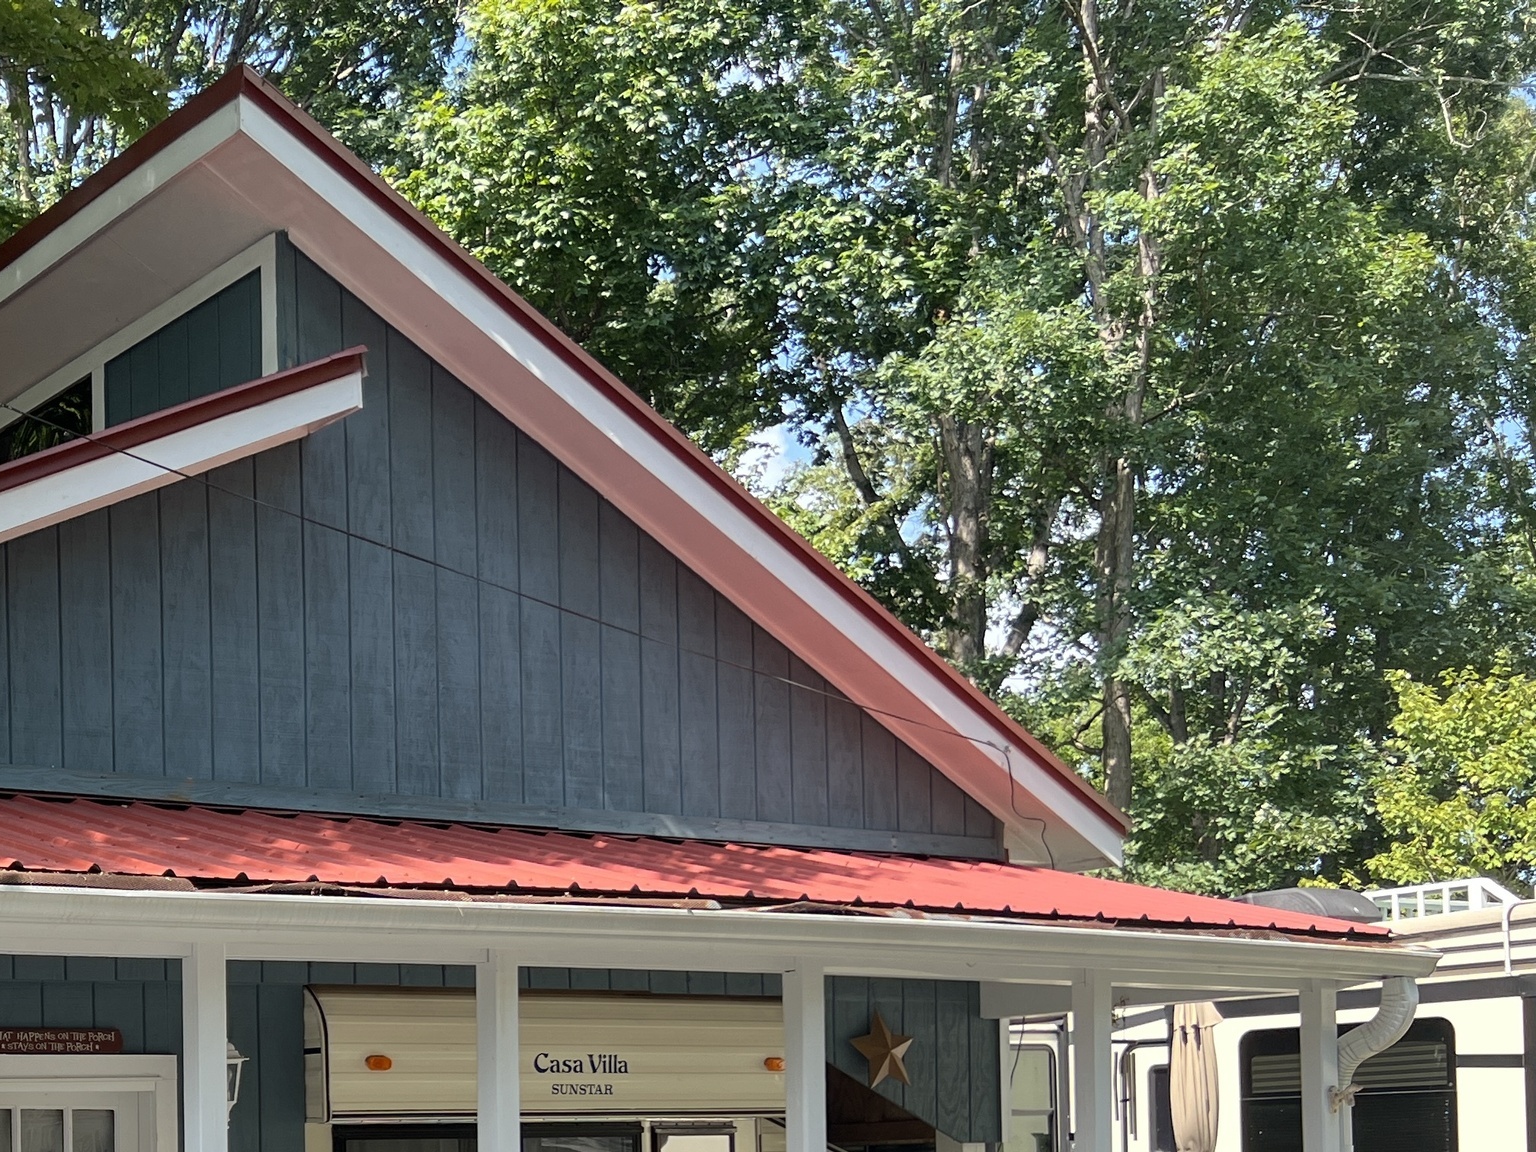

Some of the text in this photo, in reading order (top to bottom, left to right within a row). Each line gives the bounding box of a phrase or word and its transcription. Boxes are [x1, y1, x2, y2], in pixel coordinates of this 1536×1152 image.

[17, 1031, 55, 1042] HAPPENS
[57, 1031, 69, 1040] ON
[70, 1031, 86, 1041] THE
[89, 1031, 115, 1042] PORCH
[7, 1042, 93, 1052] STAYS ON THE PORCH
[533, 1052, 629, 1074] Casa Villa
[551, 1083, 614, 1095] SUNSTAR
